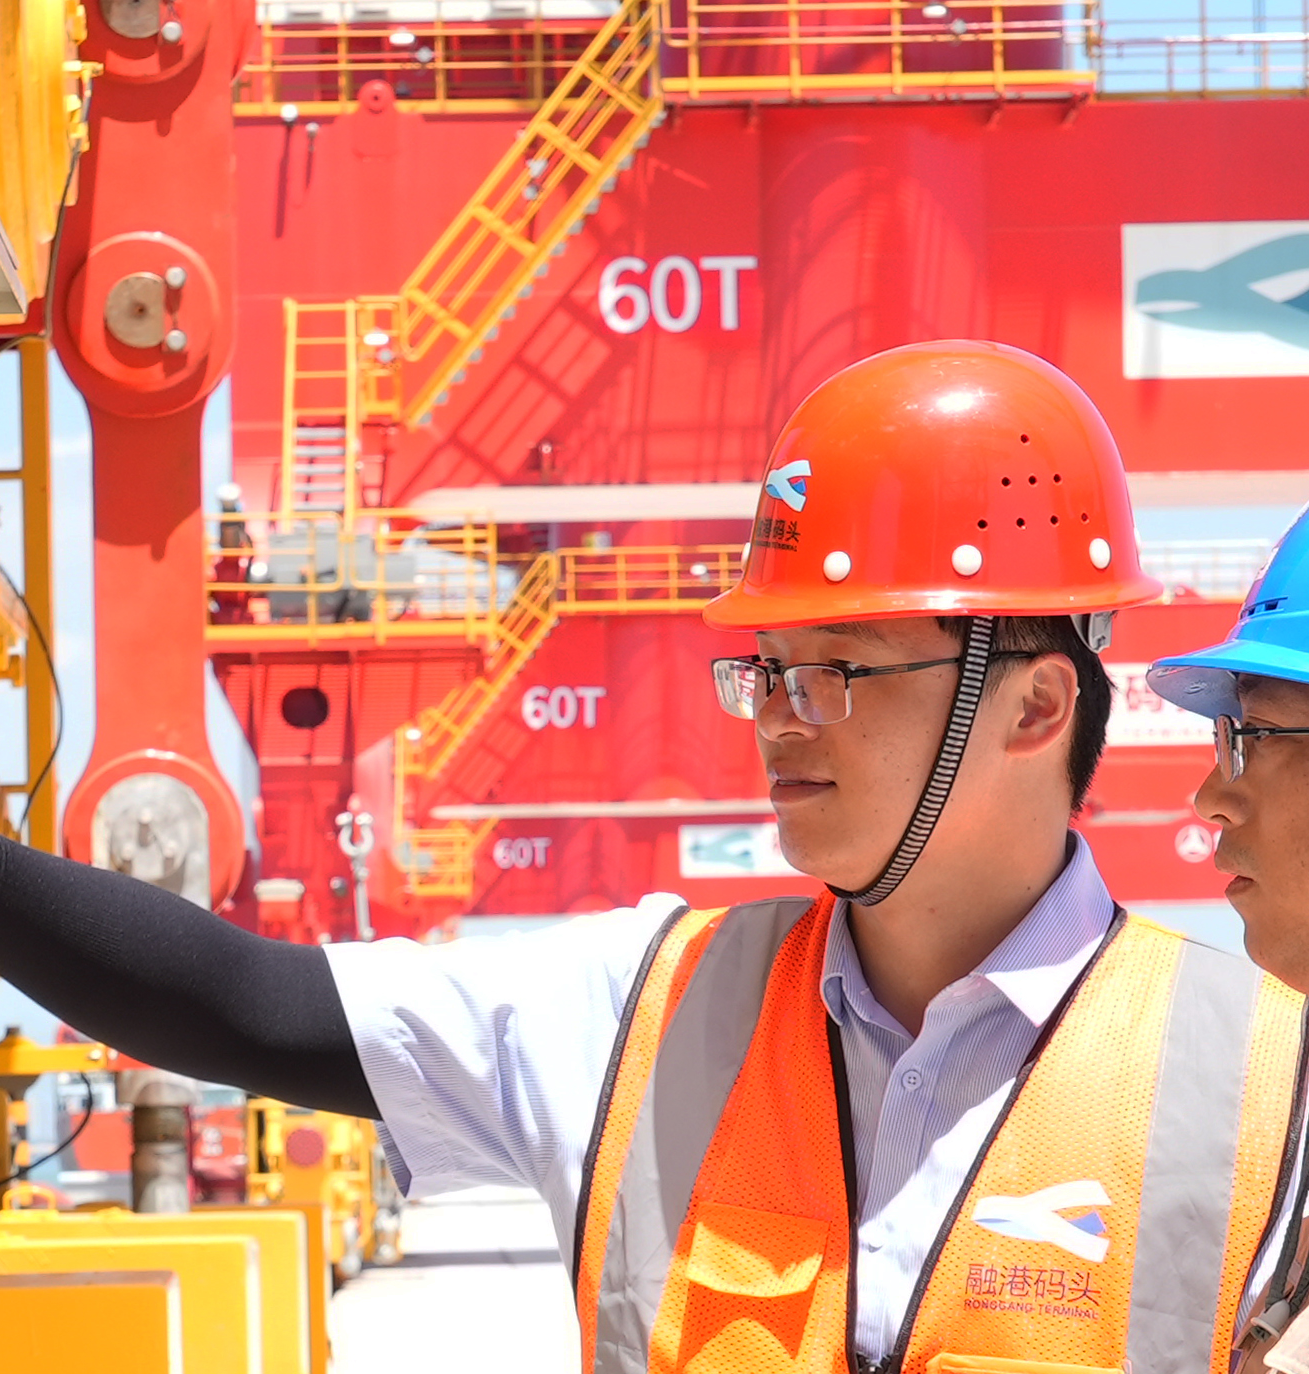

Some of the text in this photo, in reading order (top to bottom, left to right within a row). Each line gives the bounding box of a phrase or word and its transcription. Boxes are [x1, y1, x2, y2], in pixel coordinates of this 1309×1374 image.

[598, 254, 759, 335] 60T
[521, 684, 607, 731] 60T
[492, 836, 552, 870] 60T
[964, 1263, 1101, 1306] 融港码头
[963, 1298, 1100, 1320] RONGGANG TERMINAL
